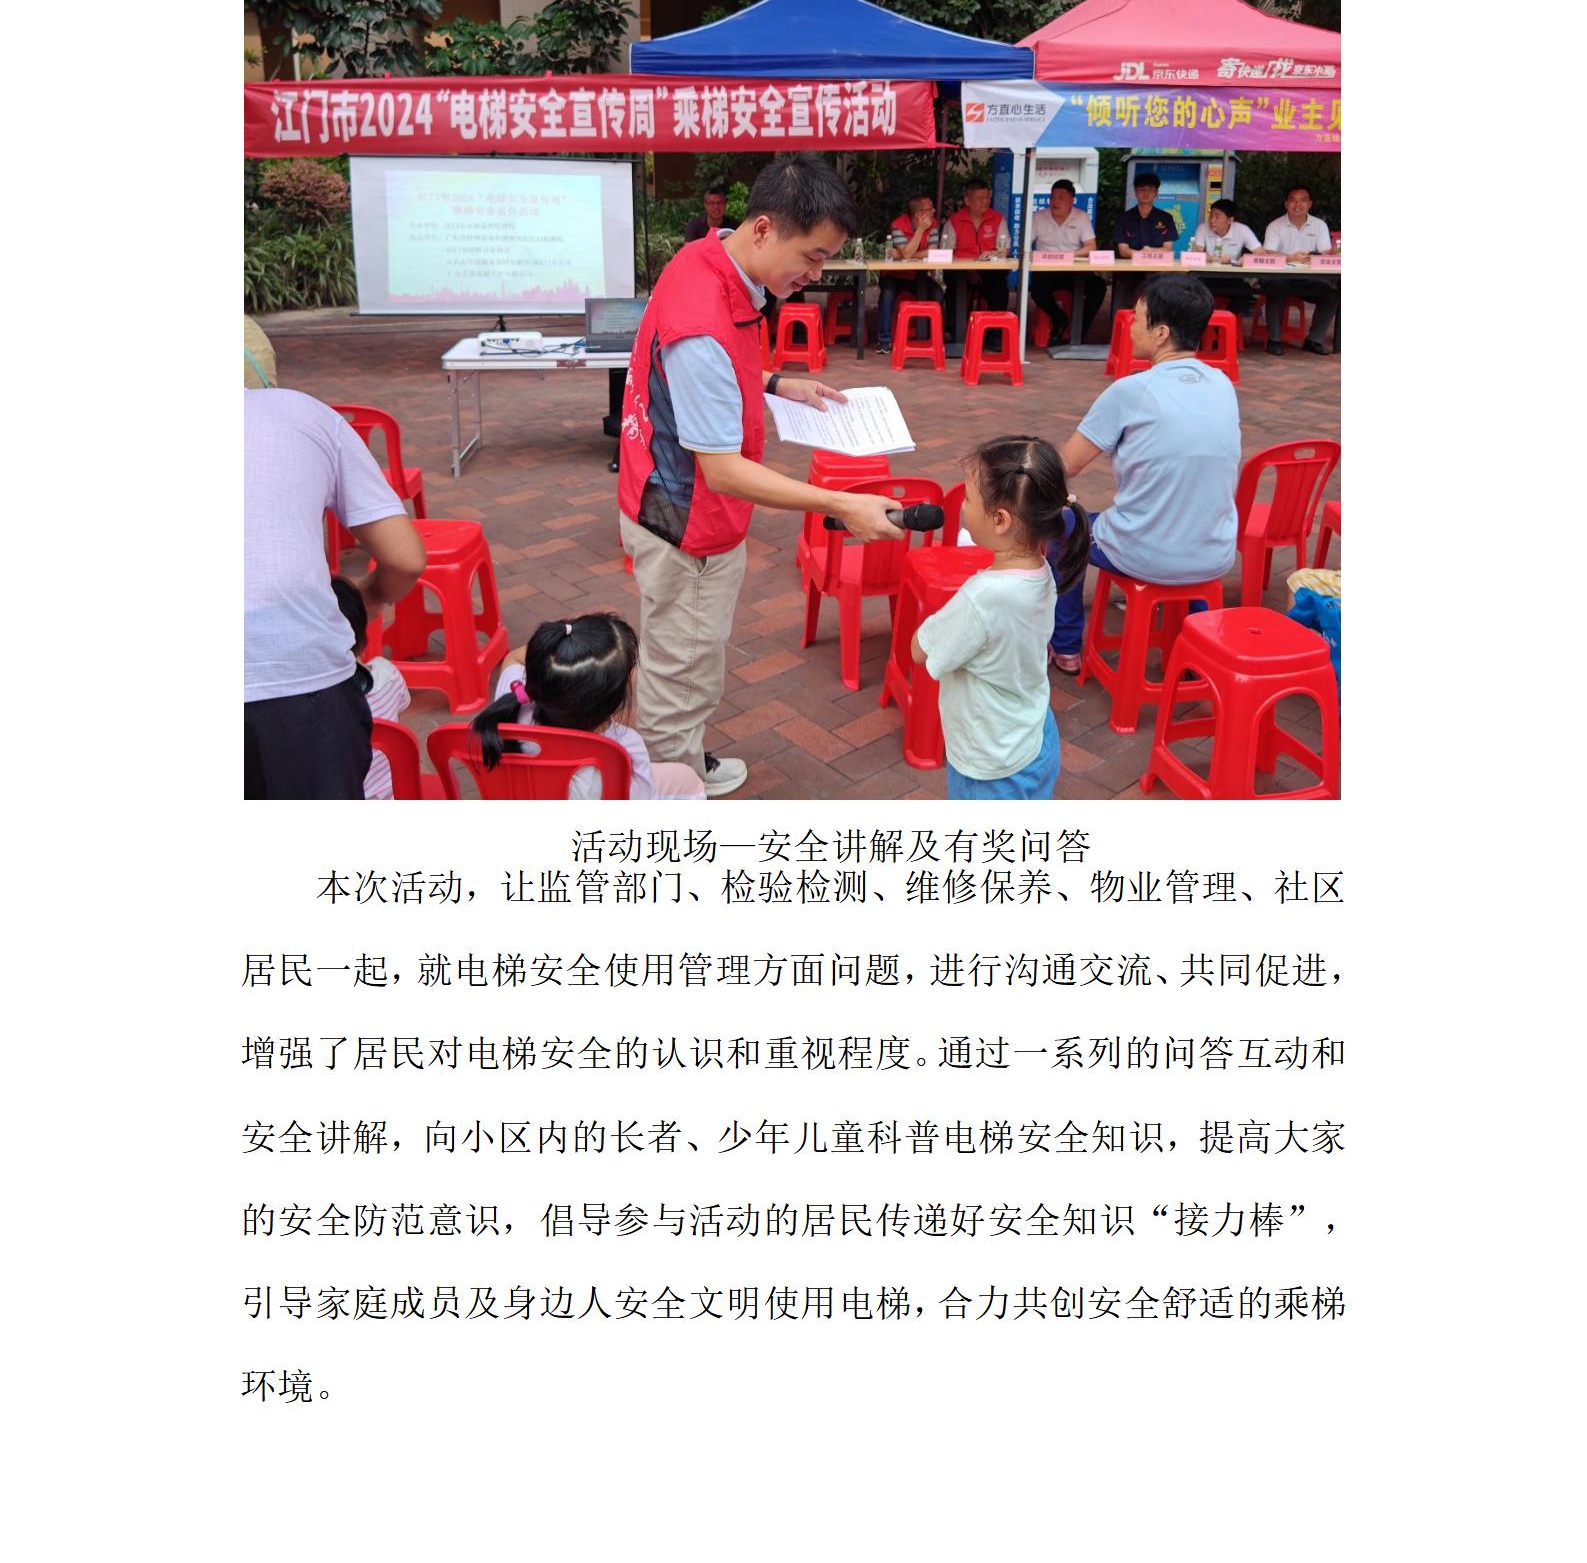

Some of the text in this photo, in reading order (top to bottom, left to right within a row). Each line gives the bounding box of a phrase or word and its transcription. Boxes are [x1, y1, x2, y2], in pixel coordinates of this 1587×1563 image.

[1113, 61, 1151, 81] JDL
[1152, 69, 1200, 81] 京东快递
[271, 81, 897, 144] 江门市2024“电梯安全宣传周”乘梯安全宣传活动
[987, 103, 1046, 116] 方直心生活
[571, 828, 1091, 864] 活动现场—安全讲解及有奖问答
[316, 868, 1344, 905] 本次活动，让监管部门、检验检测、维修保养、物业管理、社区
[241, 951, 1340, 988] 居民一起，就电梯安全使用管理方面问题，进行沟通交流、共同促进，
[241, 1034, 1345, 1071] 增强了居民对电梯安全的认识和重视程度。通过一系列的问答互动和
[242, 1118, 1345, 1155] 安全讲解，向小区内的长者、少年儿童科普电梯安全知识，提高大家
[243, 1201, 1334, 1238] 的安全防范意识，倡导参与活动的居民传递好安全知识“接力棒”，
[244, 1284, 1346, 1321] 引导家庭成员及身边人安全文明使用电梯，合力共创安全舒适的乘梯
[241, 1368, 329, 1404] 环境。
